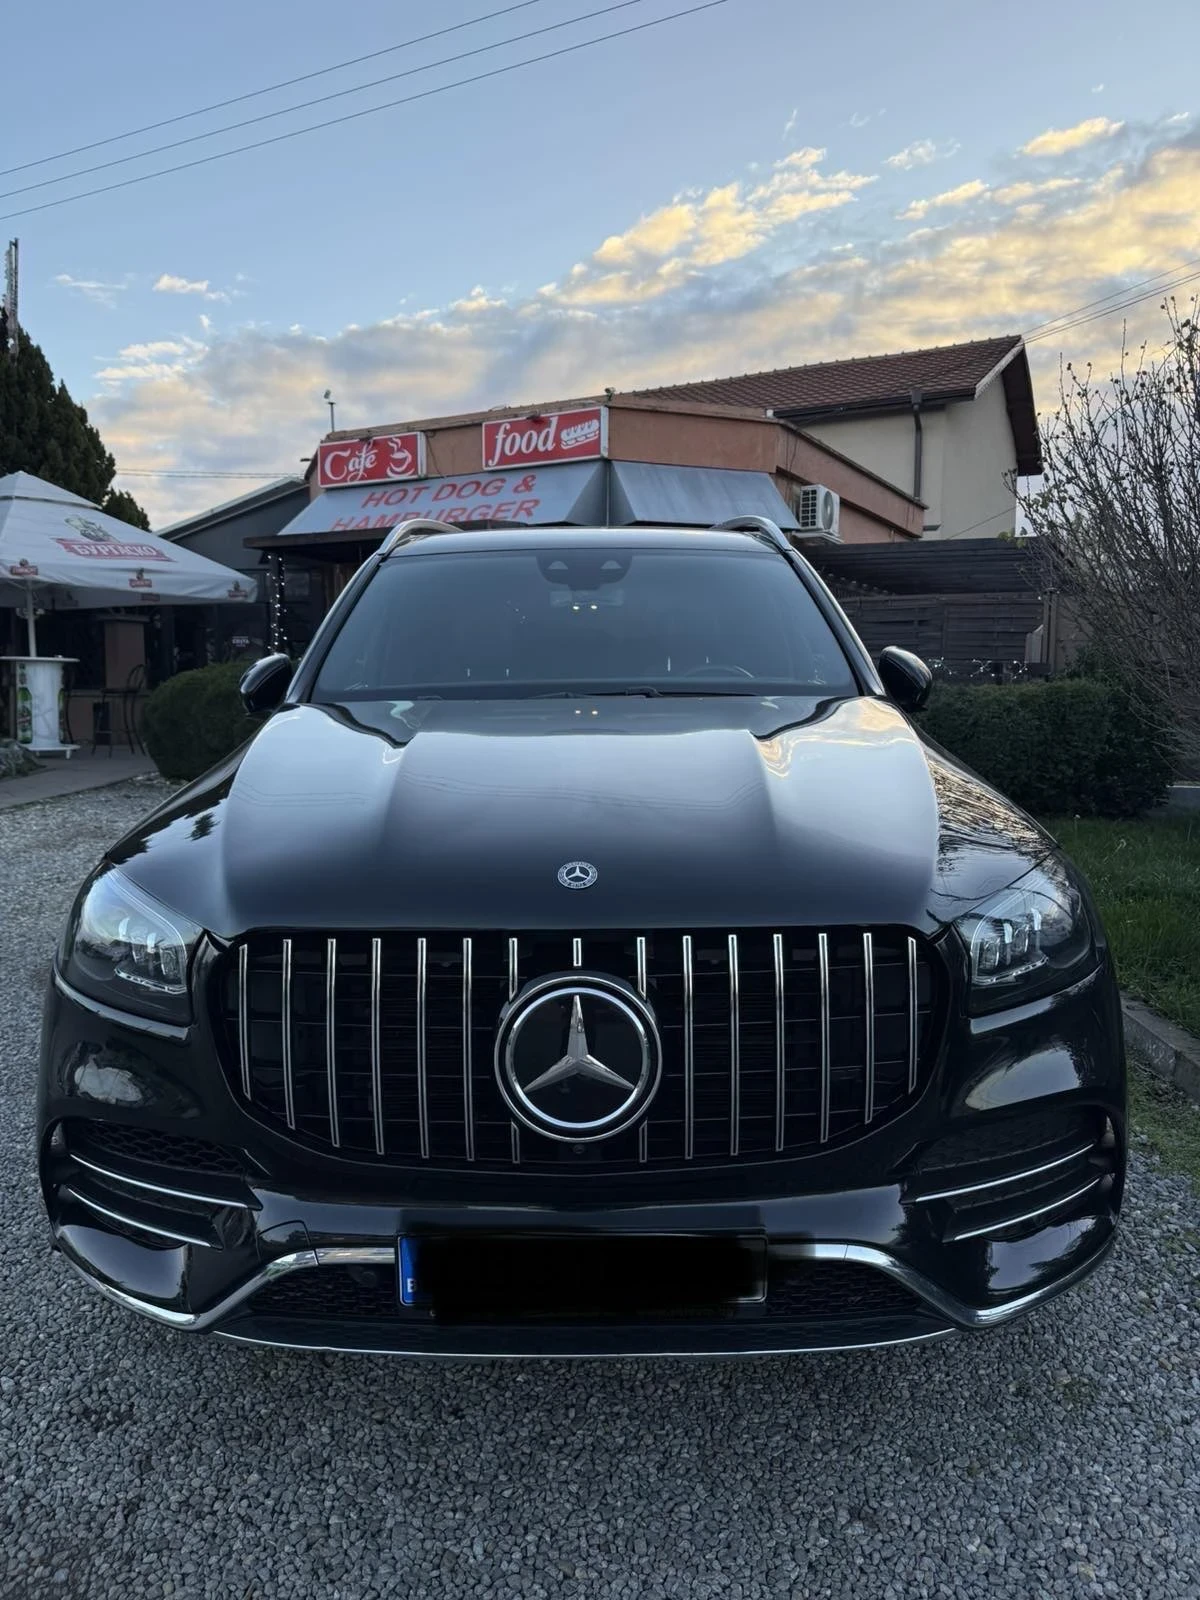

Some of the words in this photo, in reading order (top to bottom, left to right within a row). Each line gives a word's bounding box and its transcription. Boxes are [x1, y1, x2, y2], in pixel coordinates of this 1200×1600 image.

[488, 416, 559, 466] food
[361, 485, 430, 508] HOT
[432, 477, 506, 502] DOG
[513, 474, 537, 494] &
